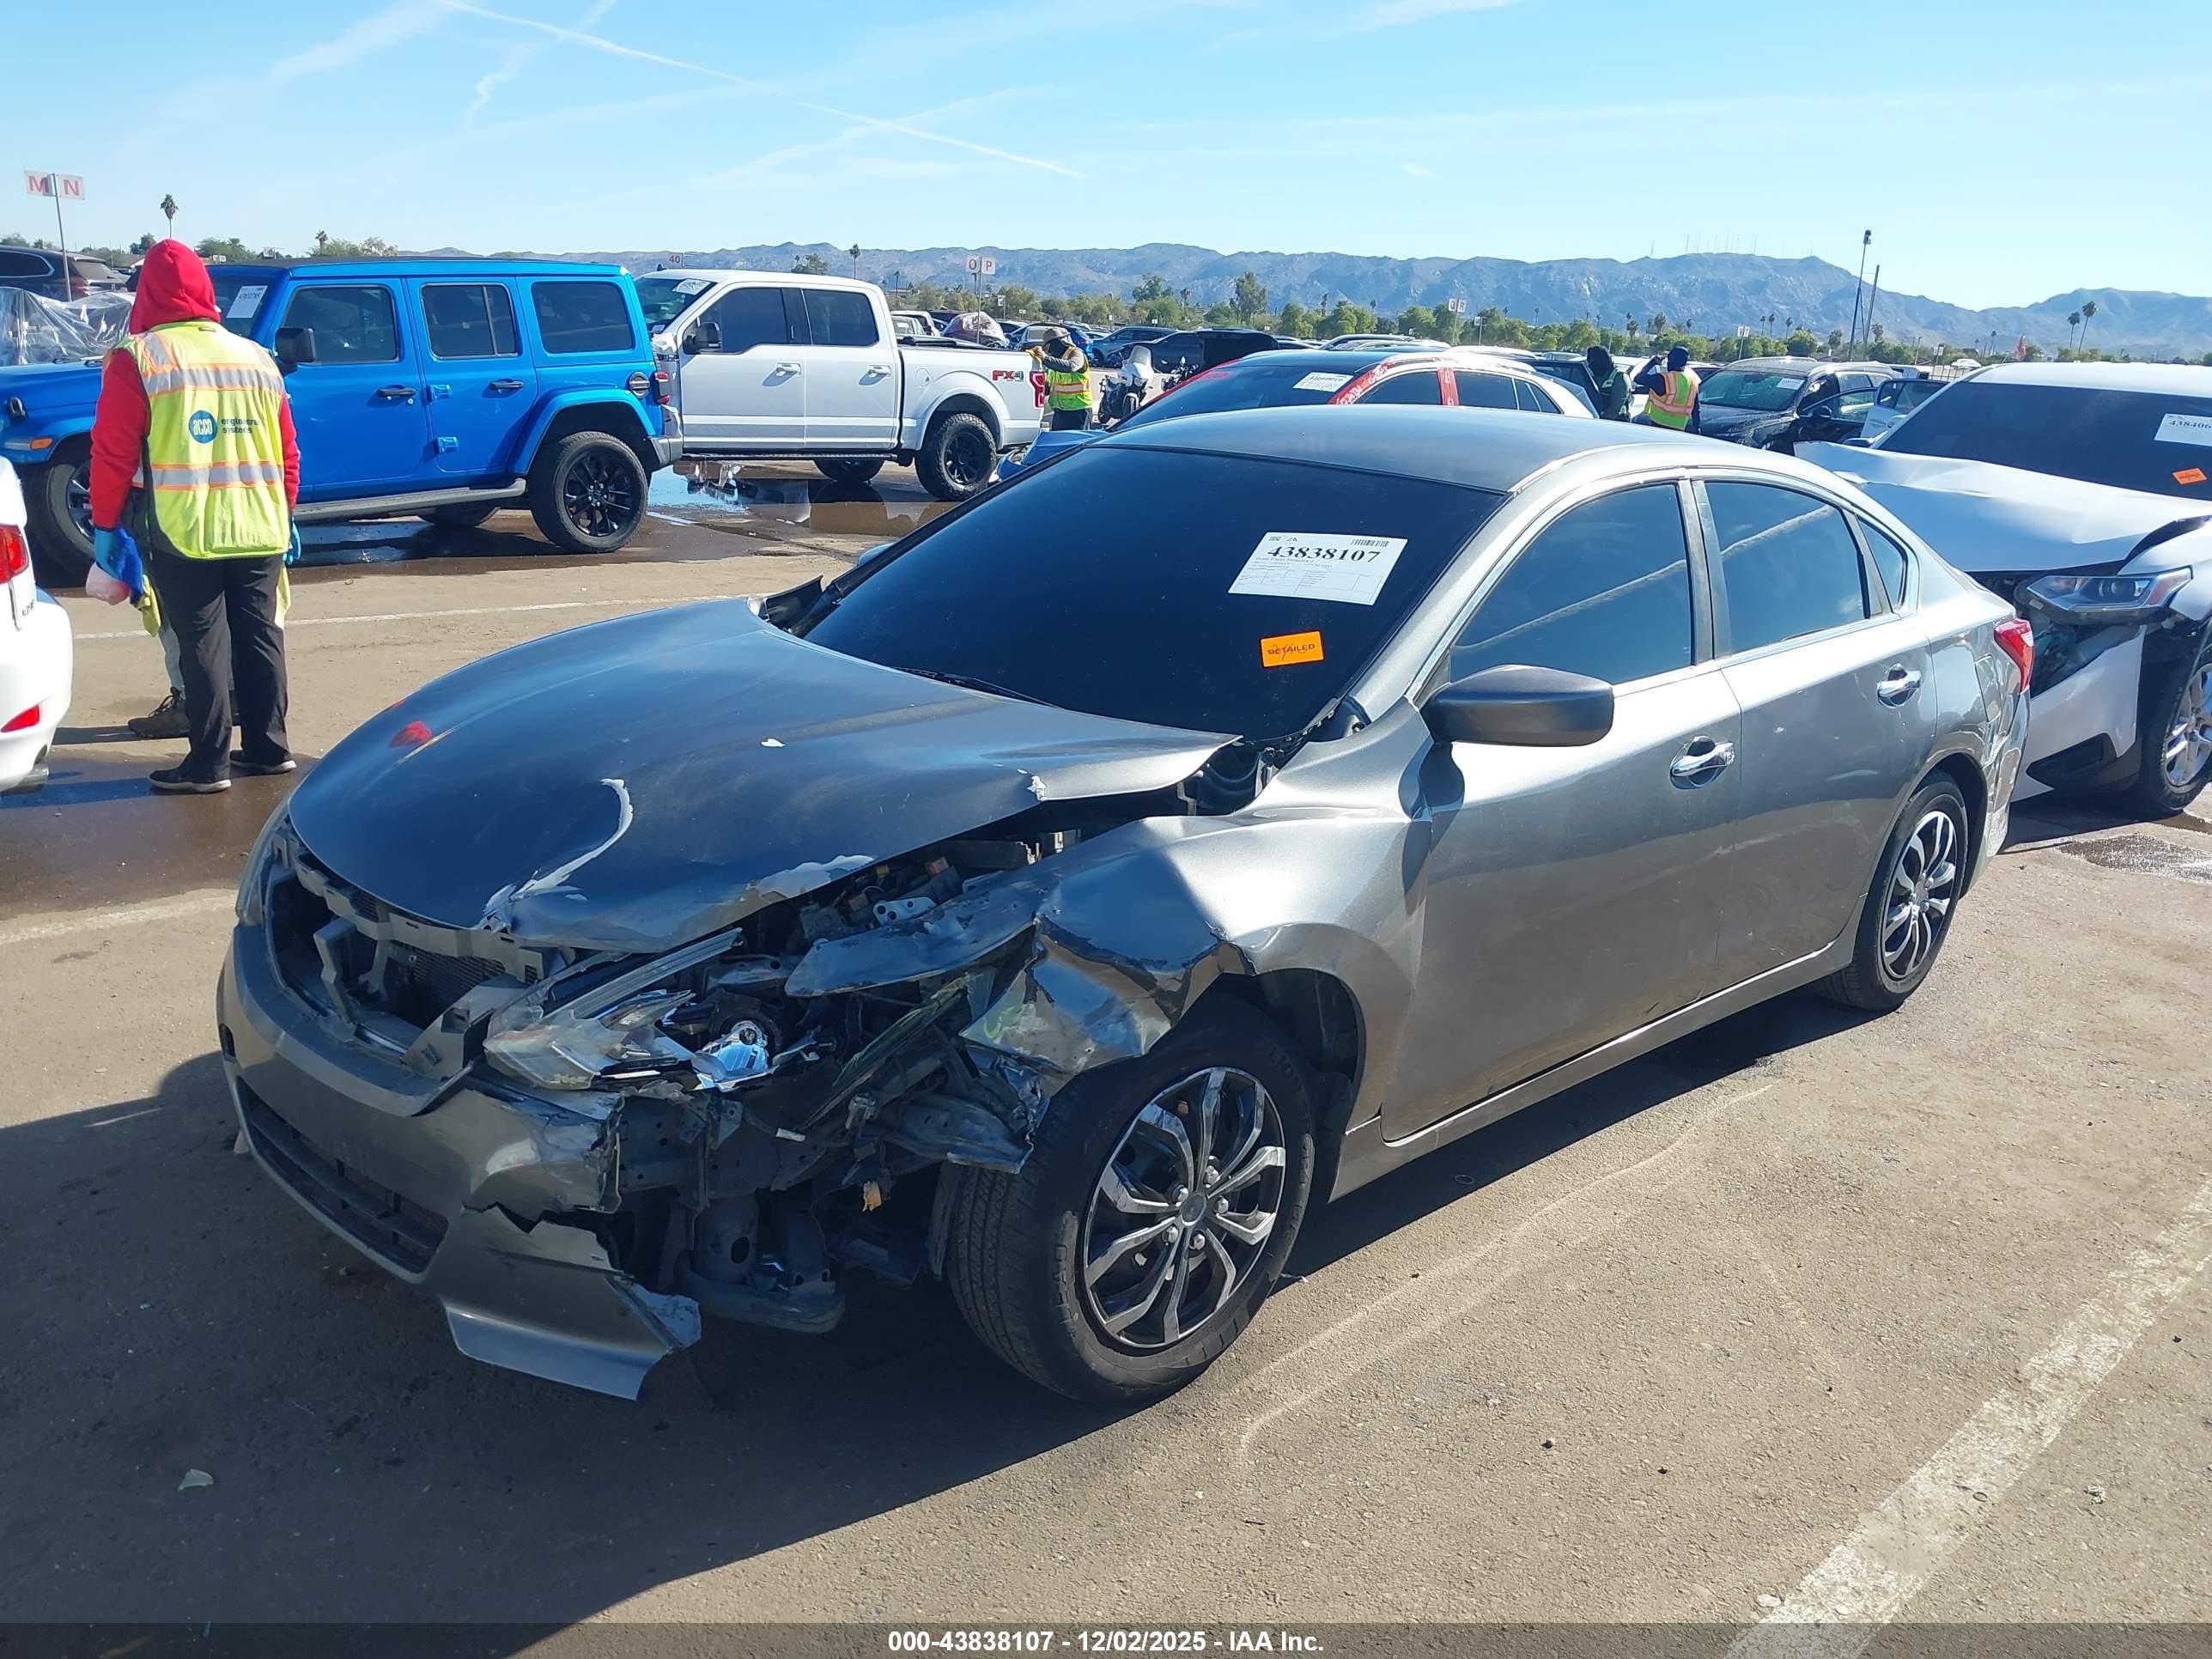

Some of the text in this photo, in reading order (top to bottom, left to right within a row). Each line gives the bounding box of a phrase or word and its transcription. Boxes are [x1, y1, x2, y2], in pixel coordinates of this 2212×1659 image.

[28, 175, 80, 196] M N
[669, 255, 681, 264] 40
[985, 260, 993, 271] P
[992, 370, 1024, 382] FX4
[192, 418, 213, 435] acco
[1267, 545, 1382, 563] 43838107
[1267, 643, 1316, 655] DETAILED
